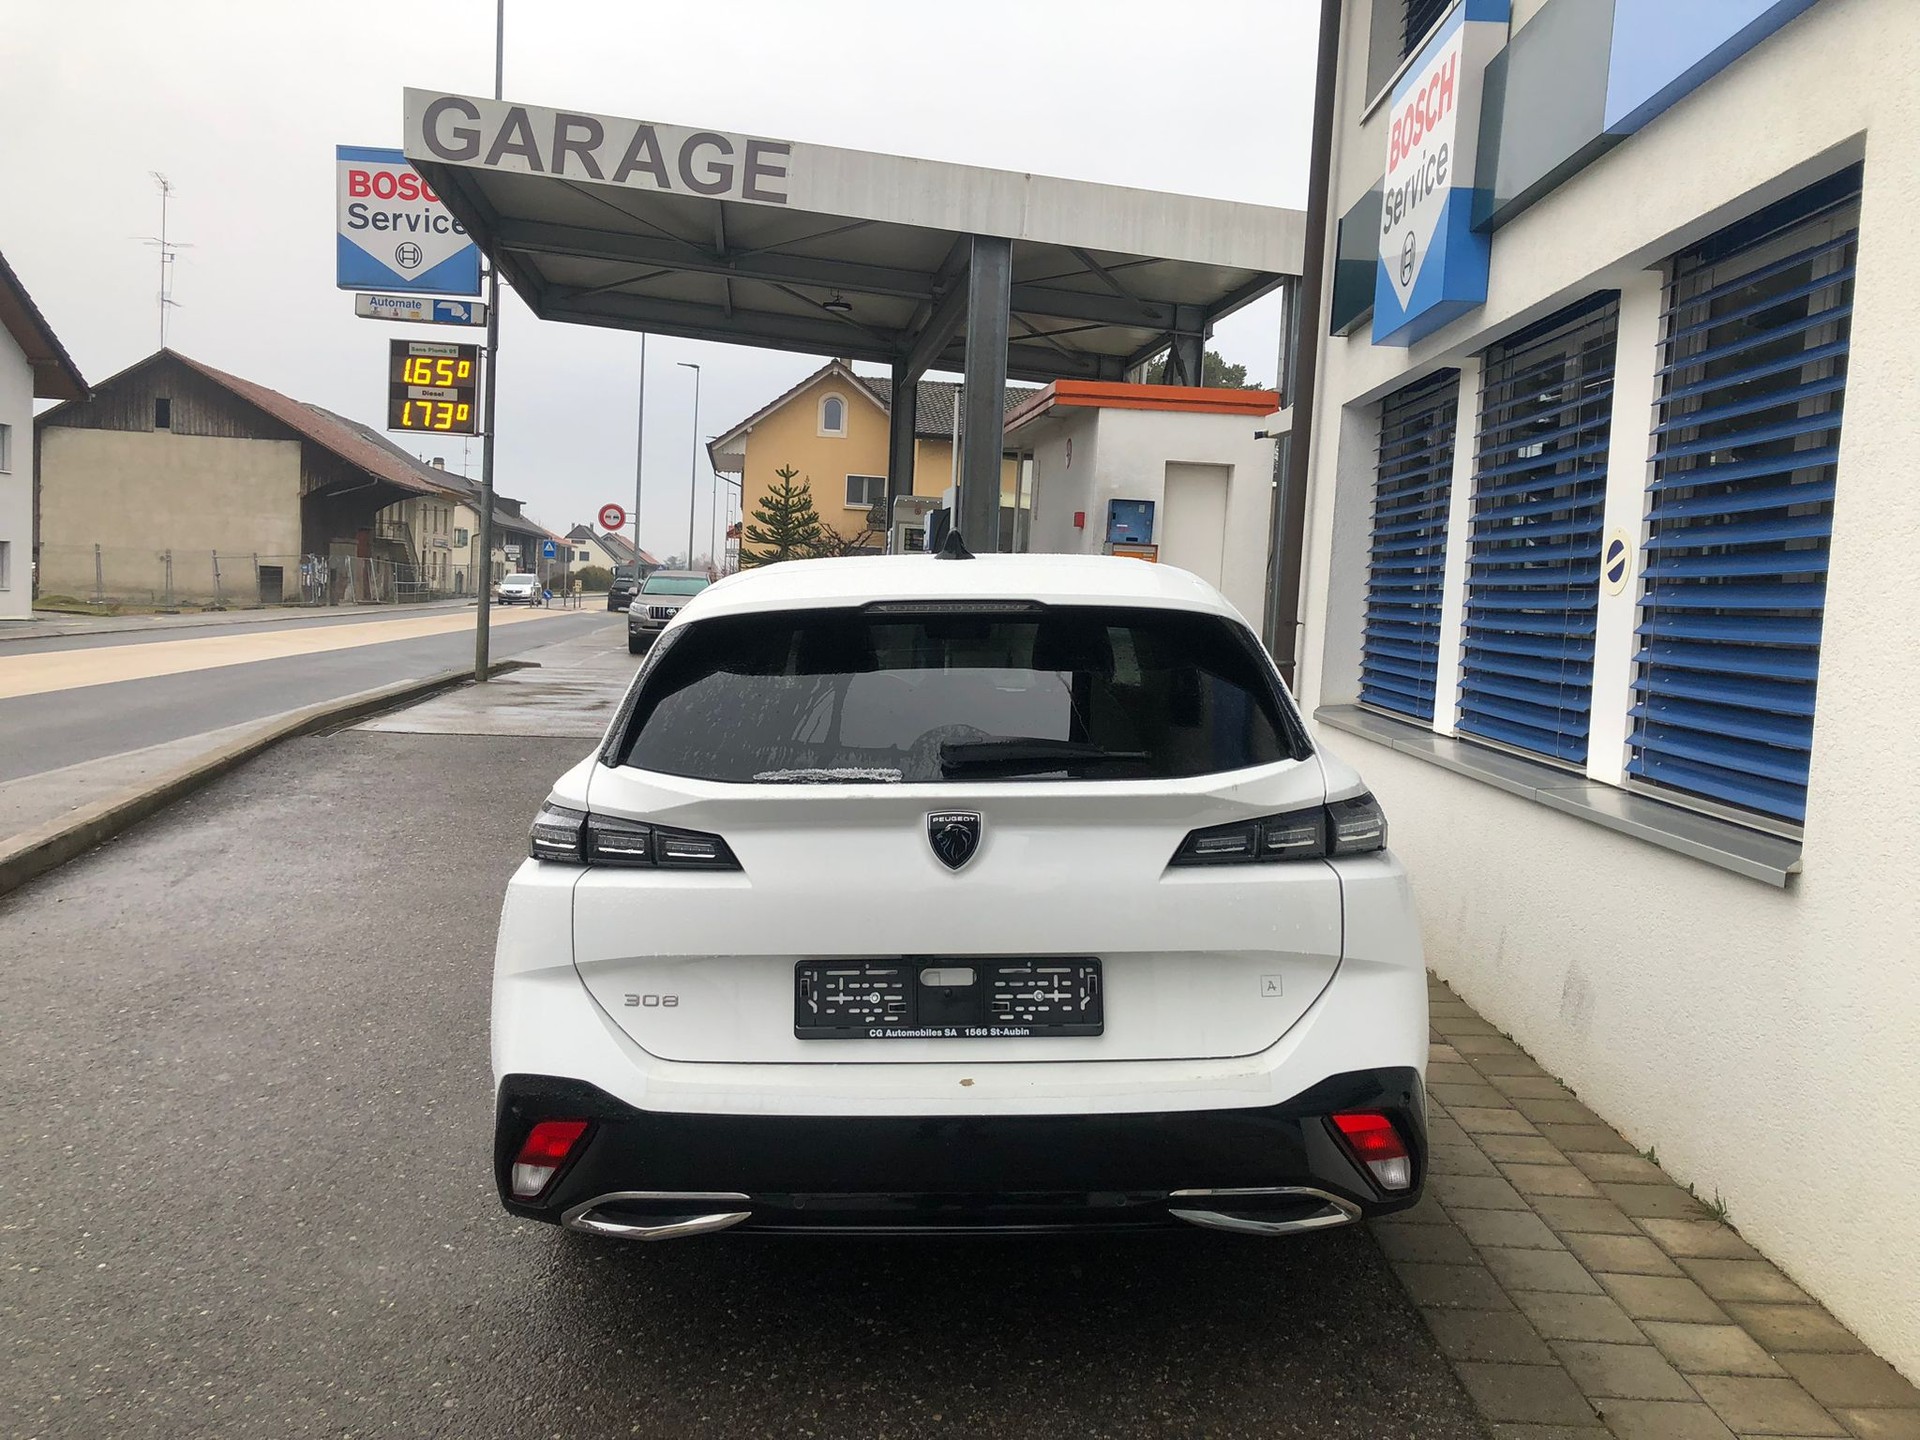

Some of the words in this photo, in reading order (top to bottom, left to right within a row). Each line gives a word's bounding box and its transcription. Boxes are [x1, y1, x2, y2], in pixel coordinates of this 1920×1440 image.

[1389, 52, 1456, 175] BOSCH
[422, 96, 792, 205] GARAGE
[348, 169, 441, 203] BOSC
[1383, 142, 1448, 235] Service
[369, 295, 422, 310] Automate
[421, 389, 445, 398] Diesel
[624, 993, 679, 1008] 308
[869, 1029, 883, 1037] CG
[885, 1028, 942, 1037] Automobiles
[944, 1028, 957, 1037] SA
[964, 1027, 988, 1036] 1566
[990, 1027, 1030, 1036] St-Aubin
